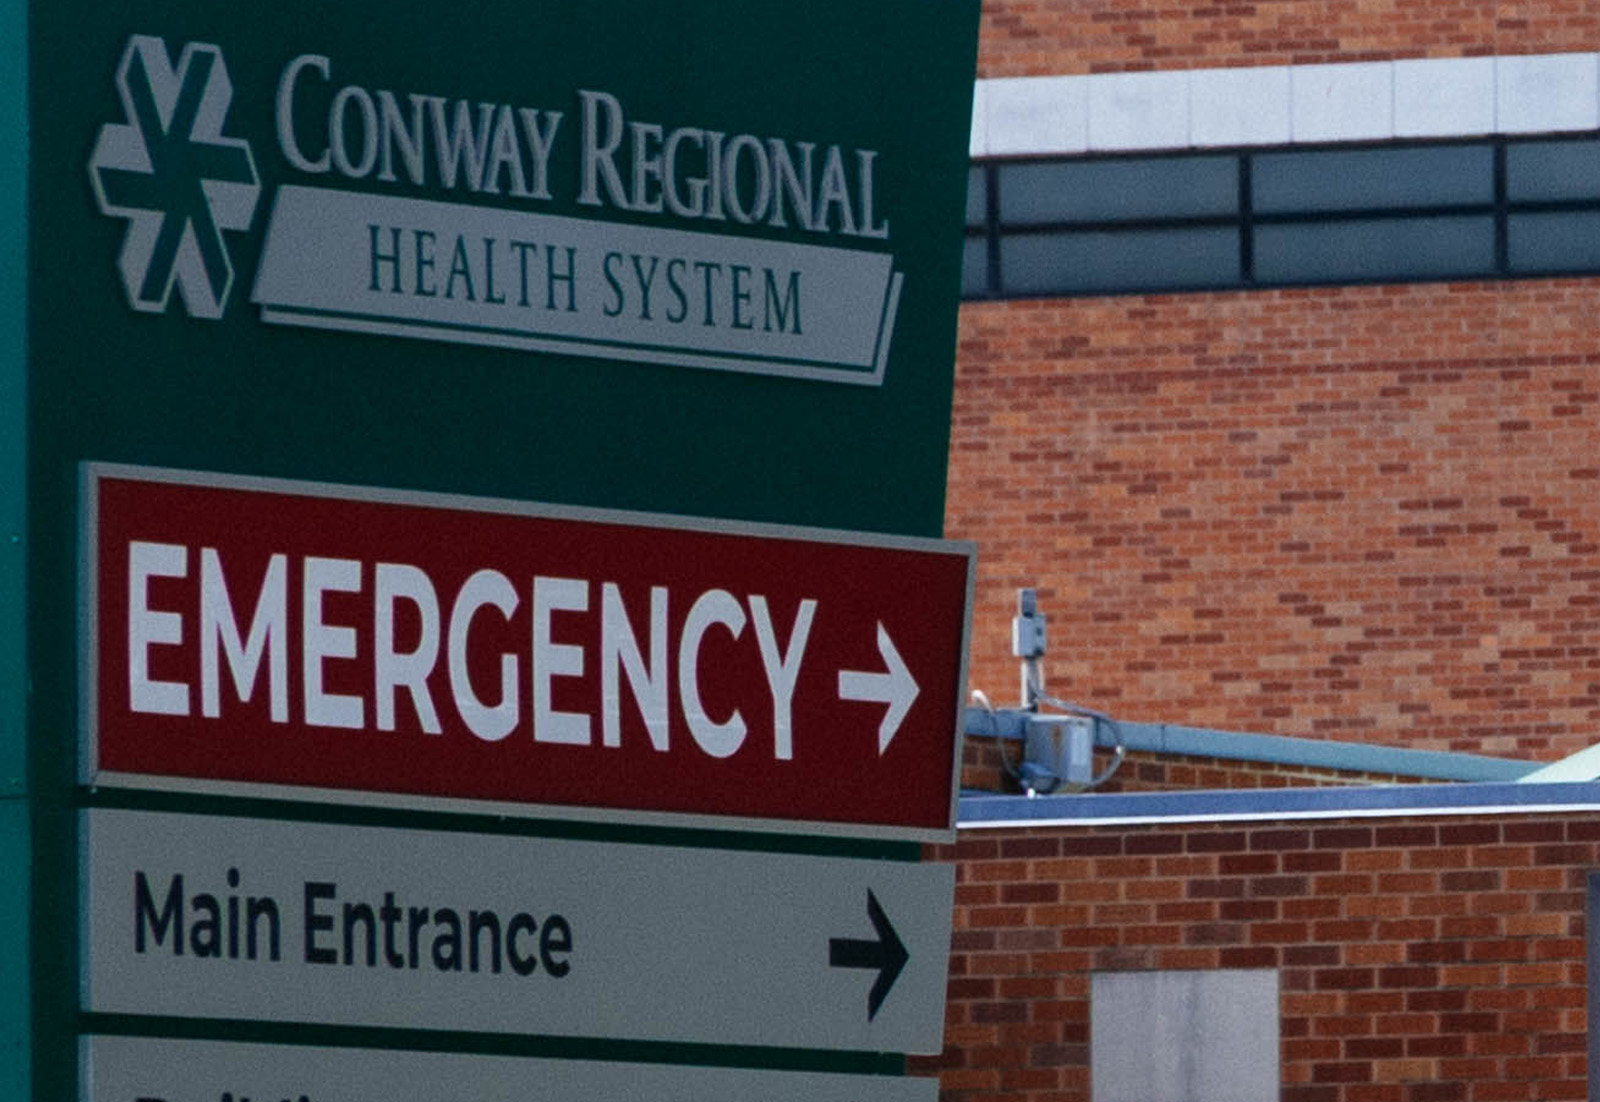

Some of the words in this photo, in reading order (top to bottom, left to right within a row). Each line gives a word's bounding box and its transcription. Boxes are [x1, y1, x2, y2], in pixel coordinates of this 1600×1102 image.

[276, 53, 563, 200] CONWAY
[577, 88, 889, 239] REGIONAL
[367, 224, 577, 314] HEALTH
[601, 254, 804, 337] SYSTEM
[127, 539, 818, 761] EMERGENCY
[133, 867, 280, 961] Main
[304, 880, 573, 980] Entrance
